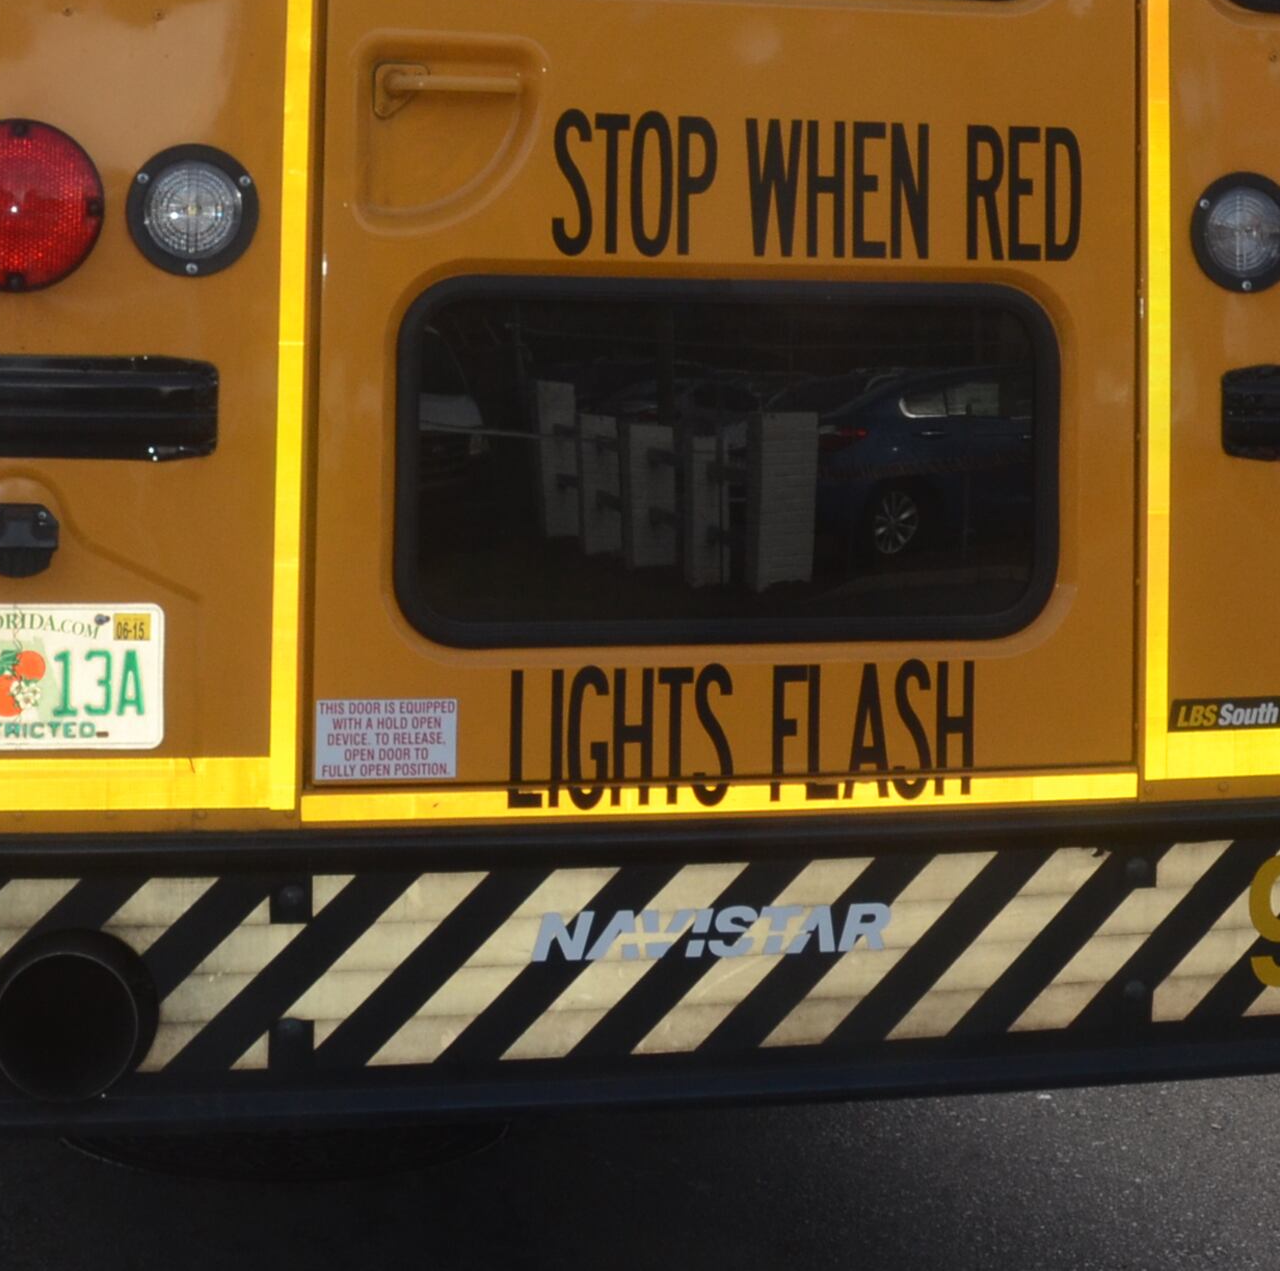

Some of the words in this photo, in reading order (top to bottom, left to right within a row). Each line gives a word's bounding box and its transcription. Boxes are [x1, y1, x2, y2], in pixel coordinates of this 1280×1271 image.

[550, 108, 718, 257] STOP
[746, 117, 929, 260] WHEN
[966, 124, 1083, 262] RED
[116, 620, 145, 640] 06-15
[53, 649, 145, 717] 13A
[319, 703, 345, 715] THIS
[349, 702, 381, 715] DOOR
[384, 702, 396, 714] IS
[399, 701, 456, 715] EQUIPPED
[1177, 704, 1217, 729] LBS
[1218, 702, 1279, 726] South
[332, 718, 362, 730] WITH
[366, 718, 373, 729] A
[377, 717, 408, 729] HOLD
[411, 717, 442, 729] OPEN
[375, 733, 390, 745] TO
[507, 663, 733, 810] LIGHTS
[769, 659, 975, 801] FLASH
[344, 749, 375, 761] OPEN
[378, 748, 411, 760] DOOR
[415, 748, 429, 760] TO
[321, 765, 356, 777] FULLY
[359, 764, 390, 776] OPEN
[394, 763, 450, 776] POSITION.
[532, 902, 892, 962] NAVISTAR
